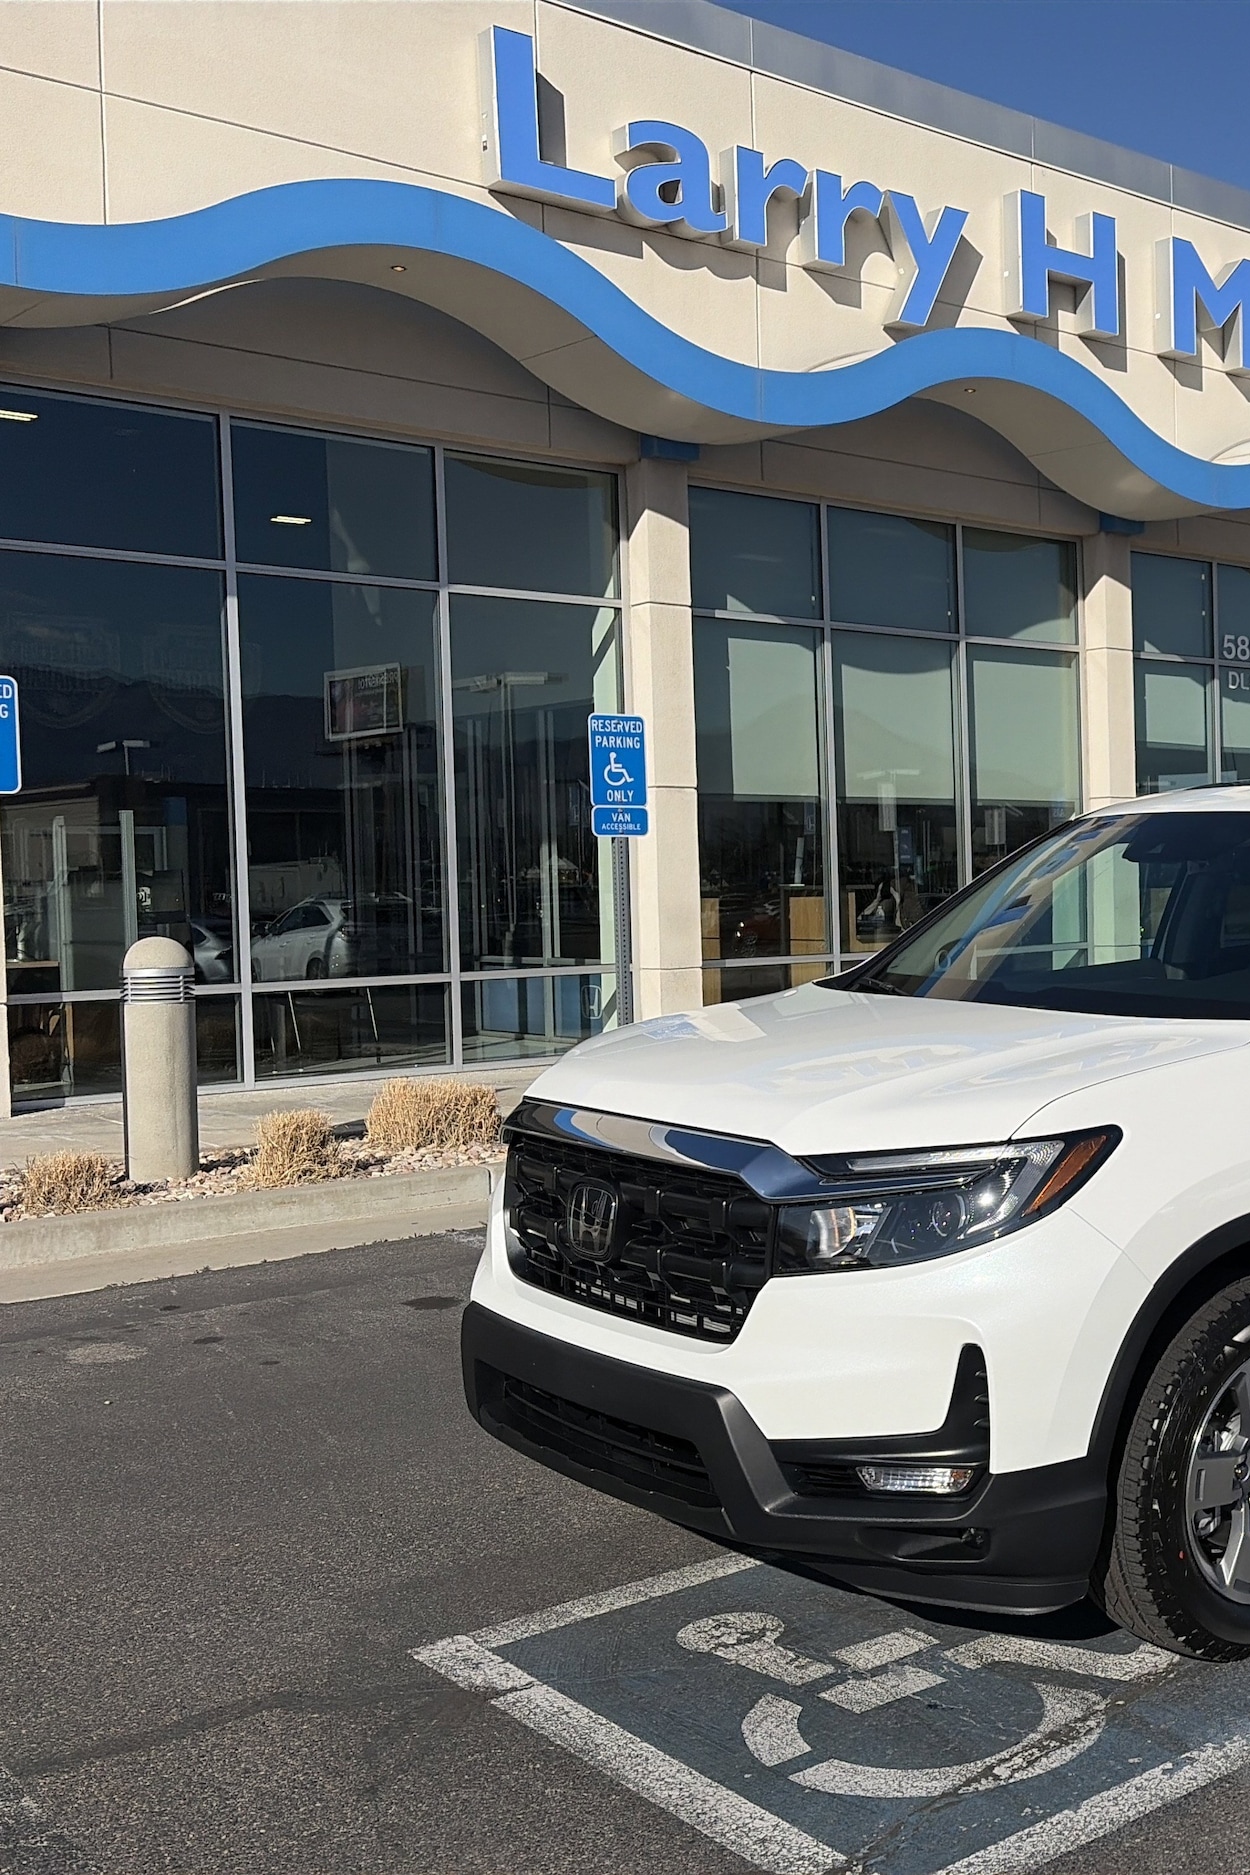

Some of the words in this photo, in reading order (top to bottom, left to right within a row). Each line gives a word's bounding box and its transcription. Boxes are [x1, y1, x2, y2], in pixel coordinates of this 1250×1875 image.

[483, 25, 969, 327] Larry
[1006, 189, 1119, 338] H
[591, 719, 643, 733] RESERVED
[595, 735, 641, 749] PARKING
[606, 789, 634, 802] ONLY
[611, 812, 631, 822] VAN
[601, 823, 641, 831] ACCESSIBLE
